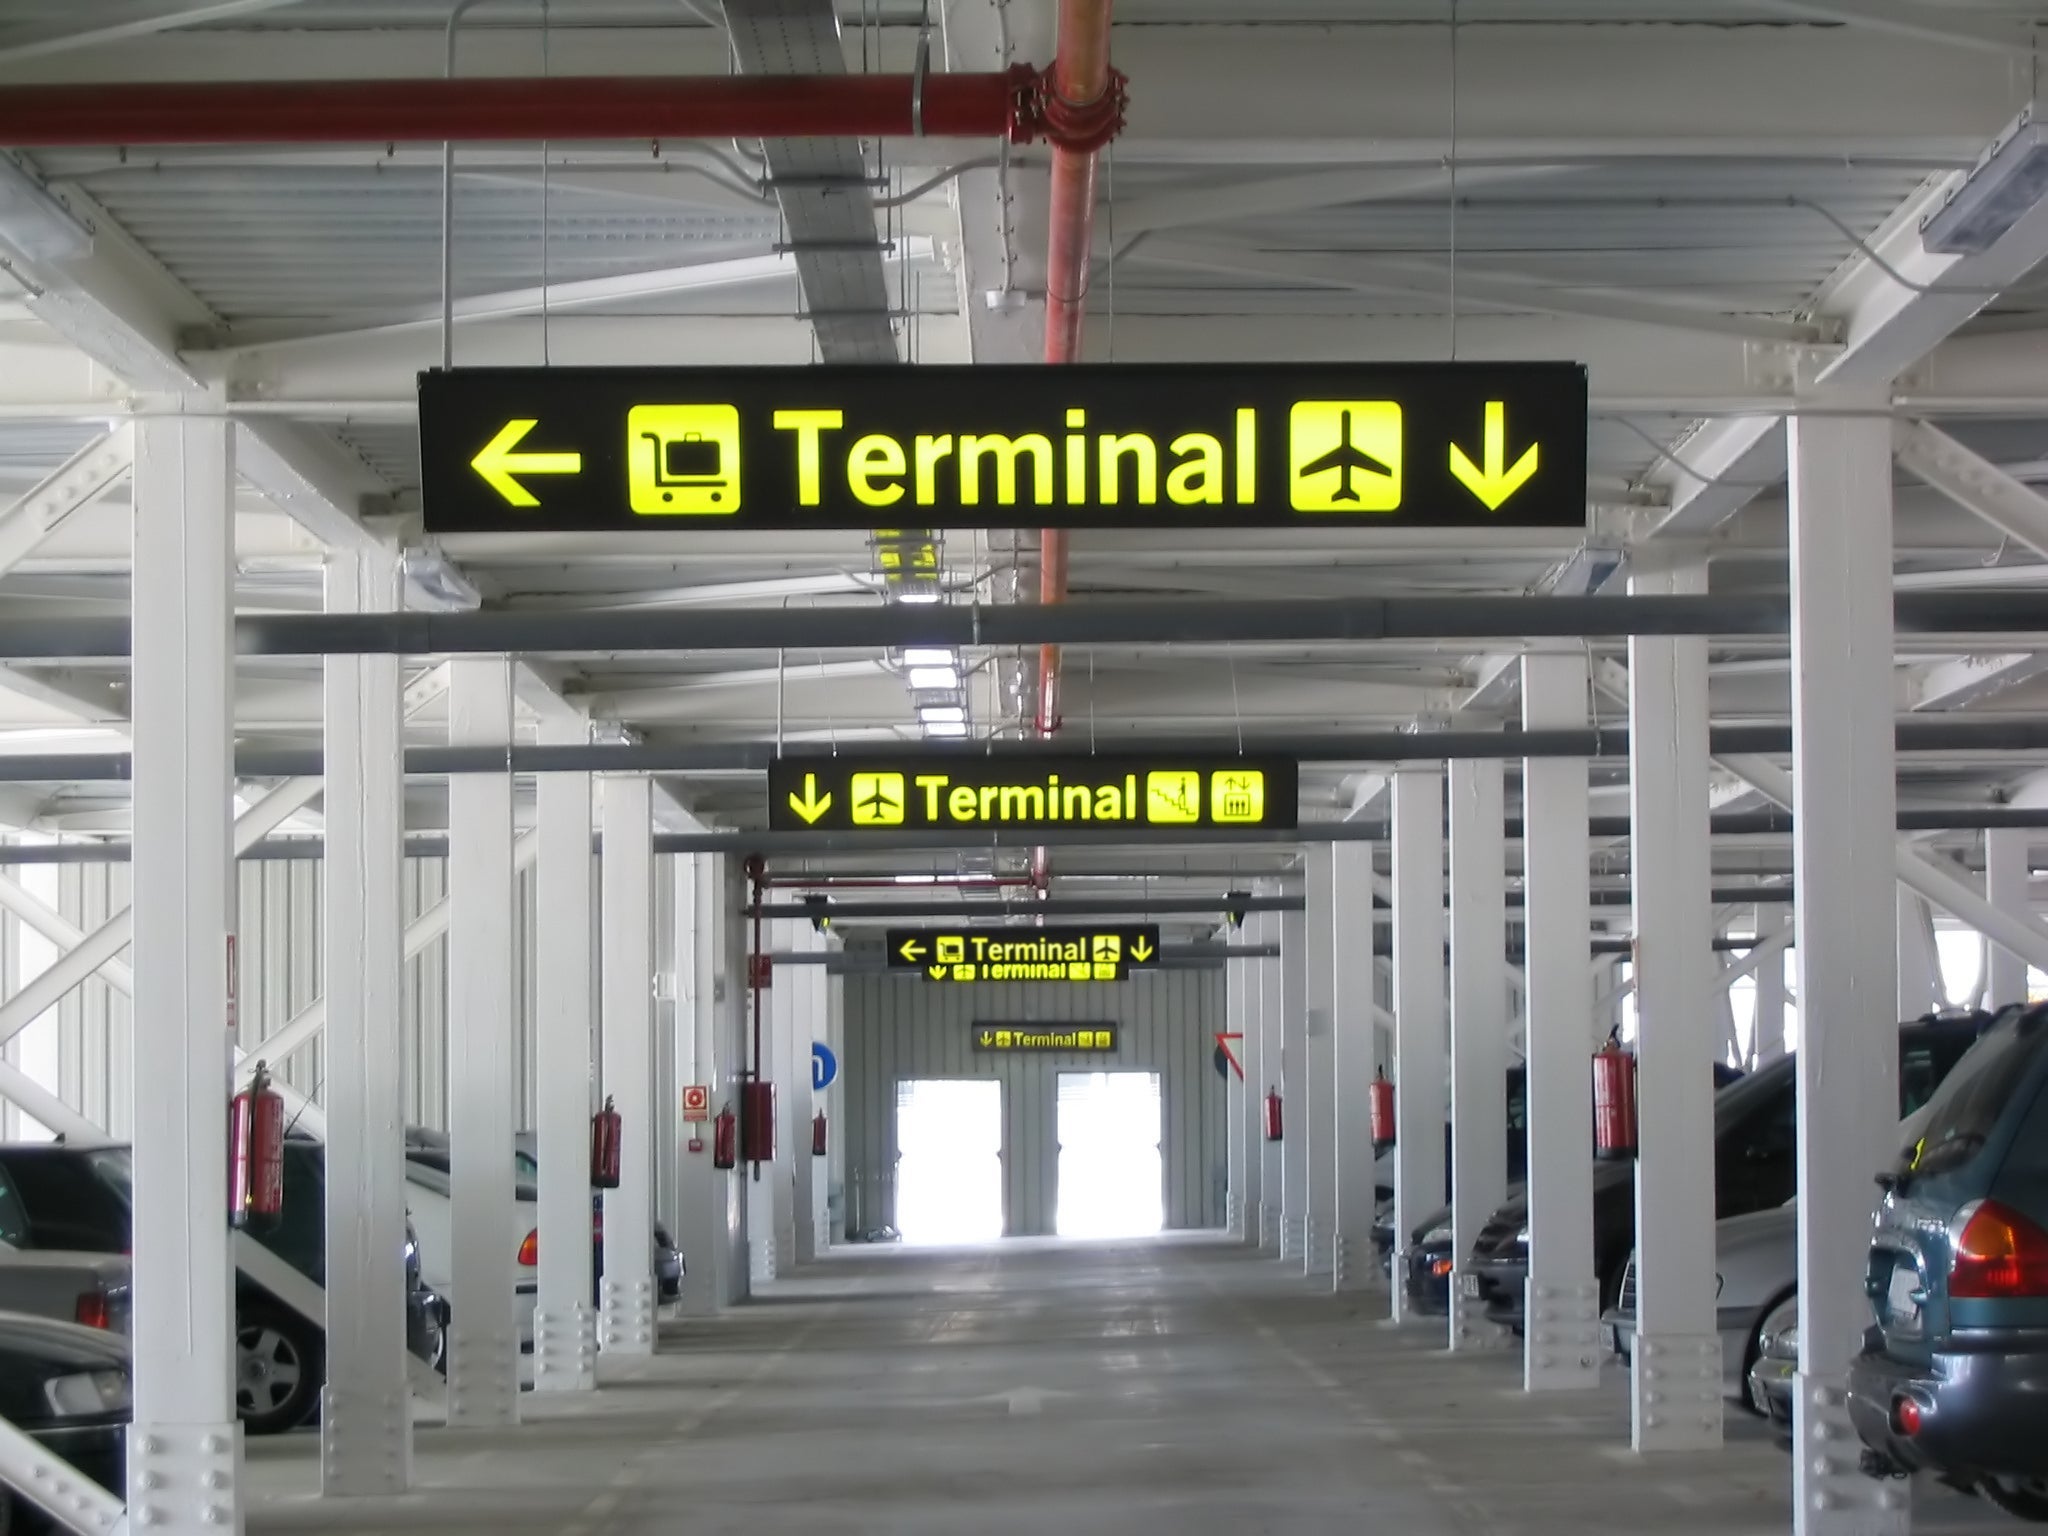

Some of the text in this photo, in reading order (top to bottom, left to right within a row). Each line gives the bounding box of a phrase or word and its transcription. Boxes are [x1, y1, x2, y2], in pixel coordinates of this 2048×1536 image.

[773, 408, 1256, 506] Terminal
[915, 774, 1136, 821] Terminal
[971, 936, 1086, 962] Terminal
[1013, 1031, 1076, 1048] Terminal
